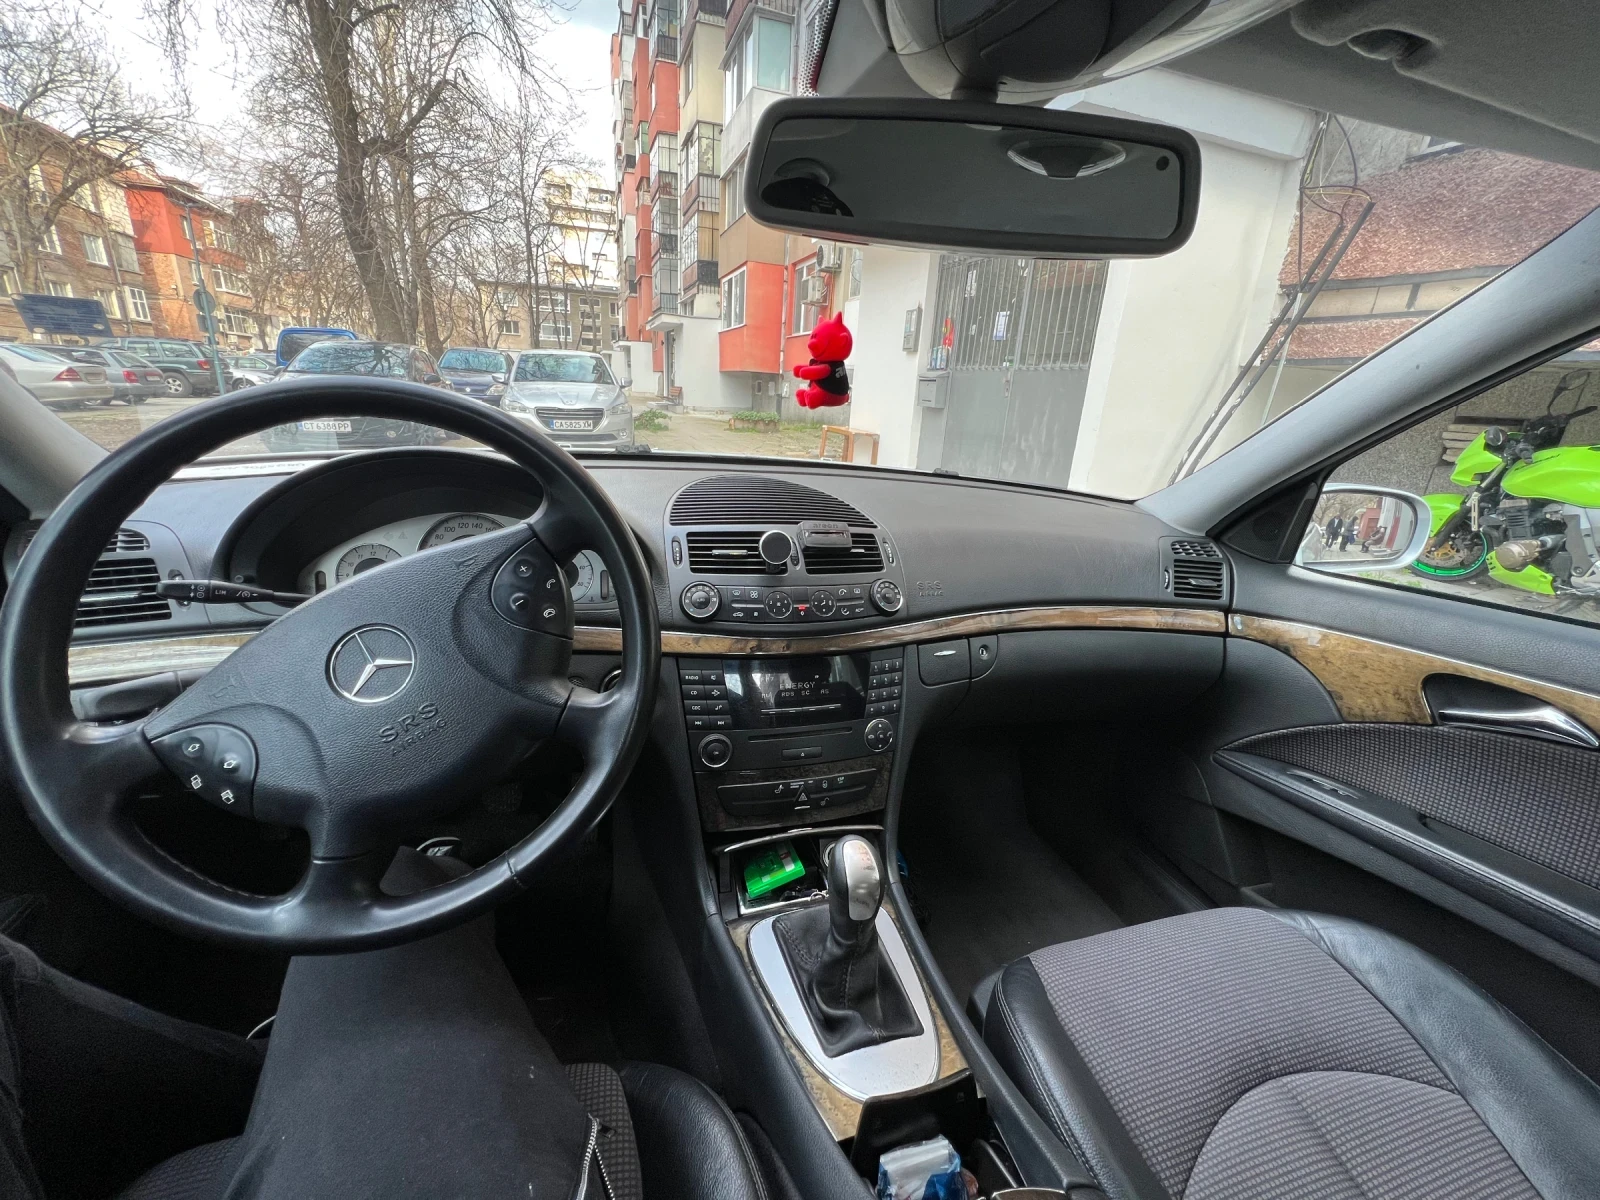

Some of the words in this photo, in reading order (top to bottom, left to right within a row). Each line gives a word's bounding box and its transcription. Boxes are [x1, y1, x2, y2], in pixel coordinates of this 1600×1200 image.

[316, 422, 337, 430] 6388
[780, 681, 815, 690] ENERGY
[379, 701, 439, 744] SRS
